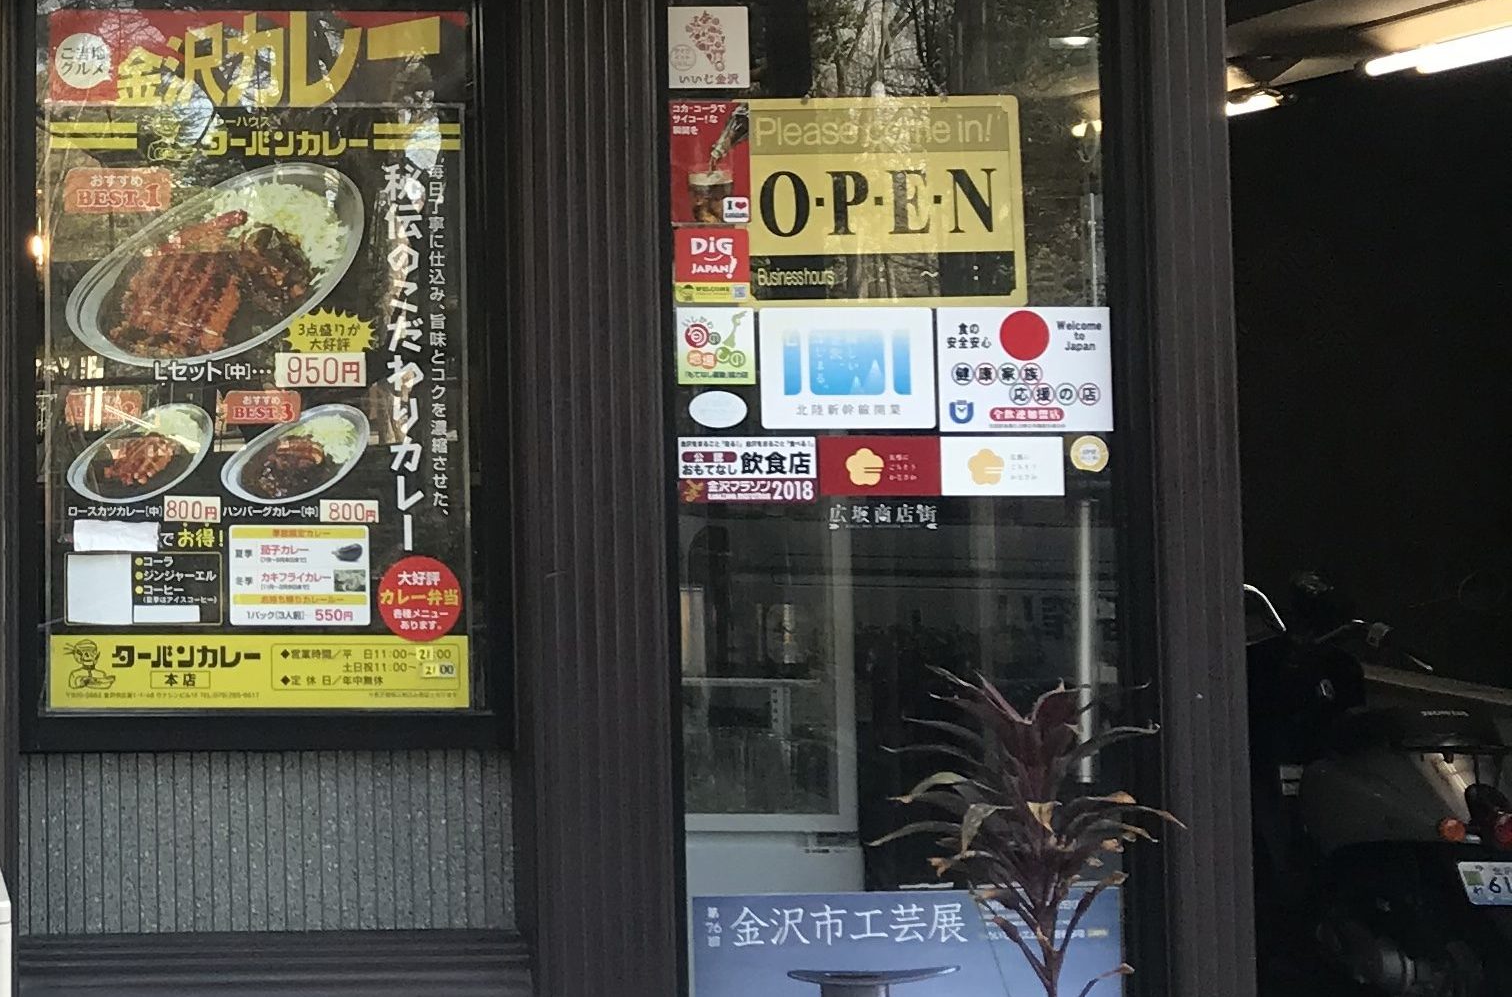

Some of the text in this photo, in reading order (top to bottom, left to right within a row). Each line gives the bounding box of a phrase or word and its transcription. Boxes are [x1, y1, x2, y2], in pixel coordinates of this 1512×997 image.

[117, 11, 439, 106] 金沢カレー
[60, 62, 105, 76] グルメ
[754, 115, 859, 146] Please
[956, 112, 993, 144] in!
[90, 174, 143, 187] おすすめ
[76, 183, 162, 208] BEST.1
[690, 255, 738, 279] JAPAN!
[298, 323, 361, 336] 3点盛りが
[957, 322, 980, 335] 食の
[1055, 320, 1103, 331] Welcome
[946, 336, 992, 349] 安全安心
[1073, 332, 1086, 341] to
[309, 338, 351, 352] 大好評
[1064, 341, 1097, 352] Japan
[384, 163, 425, 551] 秘伝のこだわりカレー
[287, 356, 360, 384] 950円
[954, 366, 1040, 382] 健康家族
[242, 395, 281, 405] おすすめ
[1012, 387, 1098, 402] 応援の店
[681, 464, 738, 475] おもてなし
[740, 451, 812, 475] 飲食店
[707, 480, 771, 493] 金沢マラソン
[772, 480, 814, 500] 2018
[166, 499, 218, 520] 800円
[328, 502, 377, 522] 800円
[829, 503, 937, 523] 広坂商店街
[143, 556, 174, 567] コーラ
[261, 572, 332, 582] カキフライカレー
[397, 570, 441, 586] 大好評
[143, 585, 184, 595] コーヒー
[379, 588, 459, 606] カレー弁当
[314, 608, 354, 622] 550円
[399, 620, 443, 630] あります。
[111, 645, 262, 669] ターバンカレー
[164, 672, 196, 687] 本店
[729, 902, 970, 948] 金沢市工芸展
